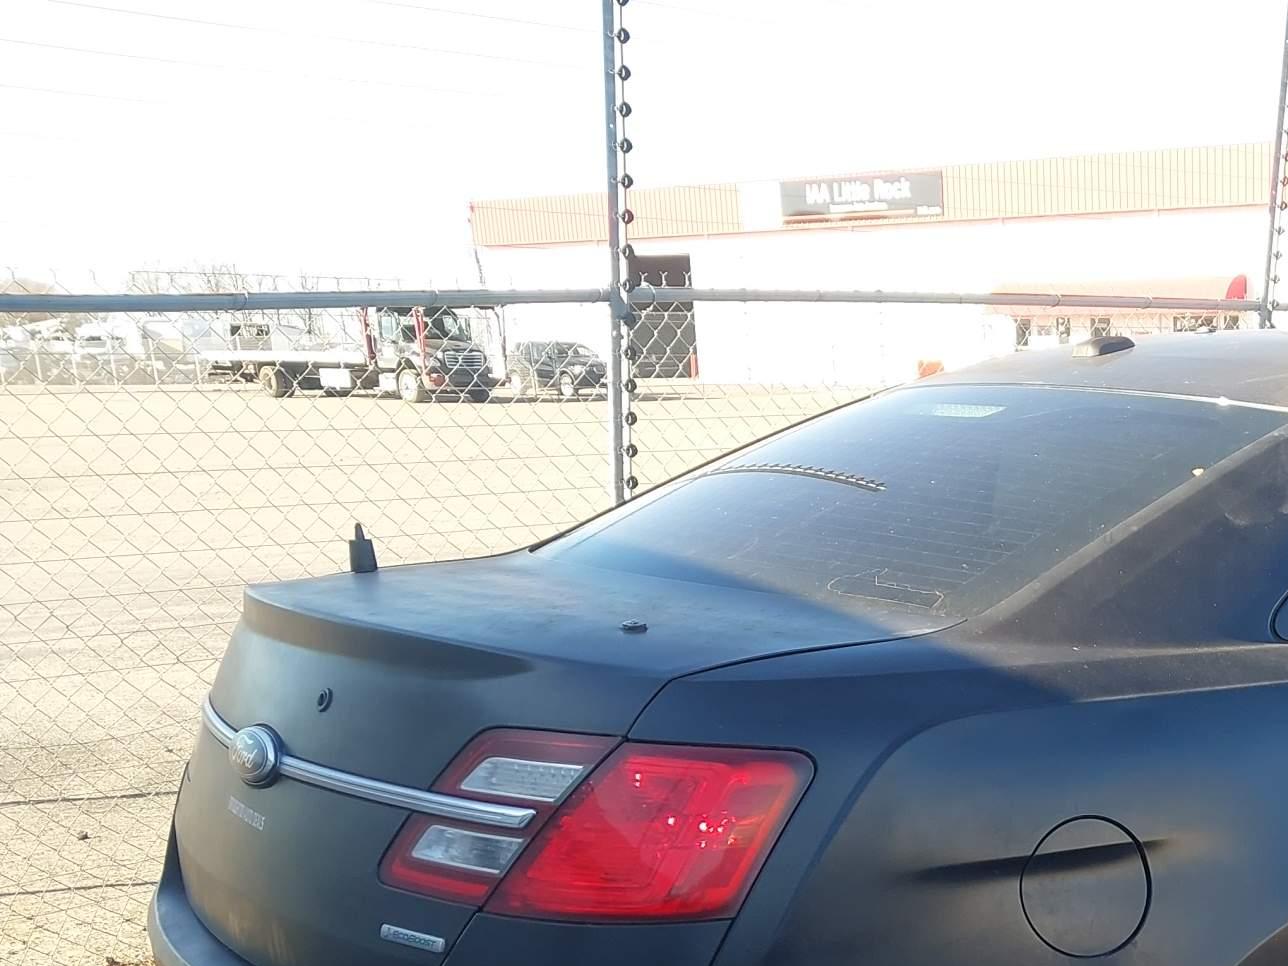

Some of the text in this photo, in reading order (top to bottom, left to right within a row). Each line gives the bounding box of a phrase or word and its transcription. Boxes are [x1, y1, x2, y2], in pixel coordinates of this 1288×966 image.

[832, 178, 871, 202] Little
[872, 176, 912, 201] Rock
[231, 733, 258, 769] Ford
